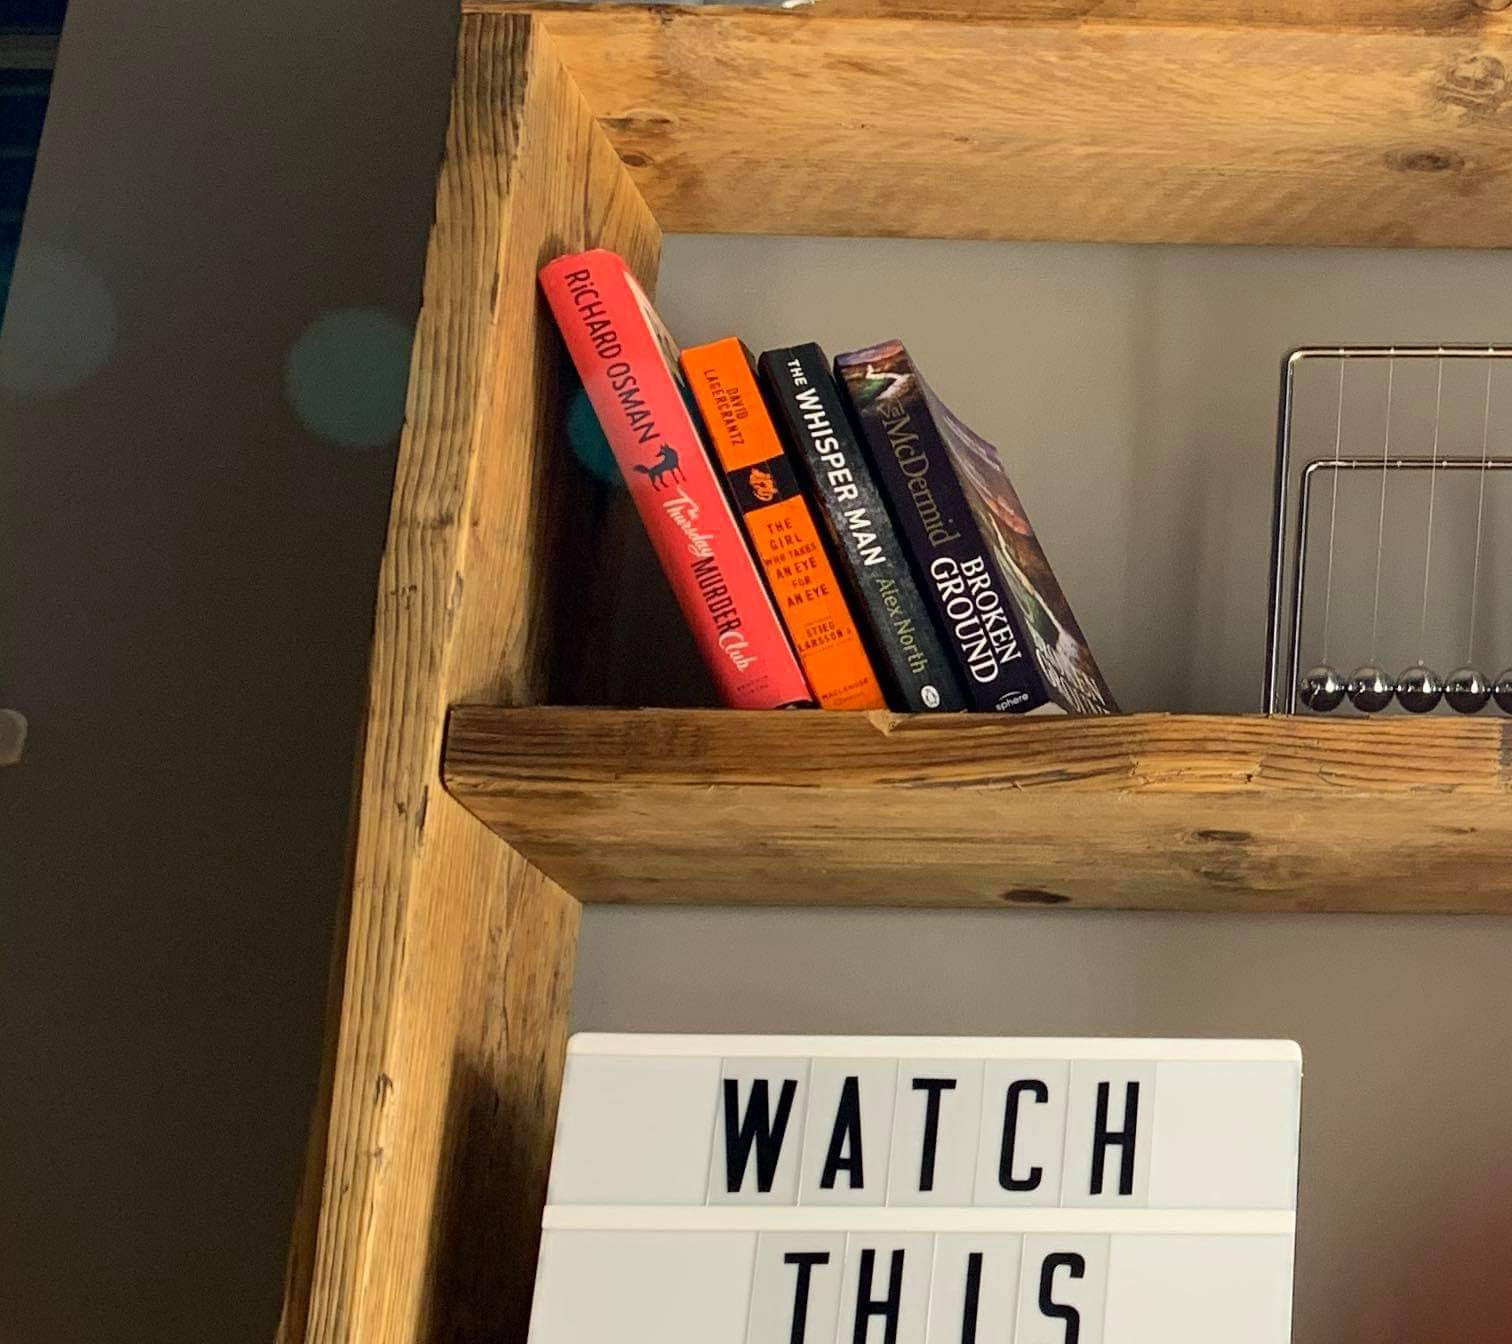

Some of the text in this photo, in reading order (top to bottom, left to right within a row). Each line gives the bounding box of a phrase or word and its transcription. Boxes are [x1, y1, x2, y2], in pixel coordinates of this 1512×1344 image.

[606, 361, 660, 445] OSMAN
[703, 369, 745, 446] LAGERCRANTZ
[725, 387, 749, 420] DAVID
[787, 358, 887, 567] THE WHISPER MAN
[882, 413, 961, 548] McDermid
[766, 518, 793, 534] THE
[769, 532, 803, 551] GIRL
[663, 485, 715, 559] Thursday
[690, 555, 743, 636] MURDER
[719, 630, 758, 673] Club
[776, 557, 818, 580] AN EYE
[787, 584, 830, 608] AN EYE
[792, 575, 812, 588] FOR
[876, 576, 929, 675] Alex North
[930, 556, 999, 684] GROUND
[961, 555, 1023, 665] BROKEN
[996, 691, 1029, 712] sphere
[723, 1076, 1140, 1197] WATCH
